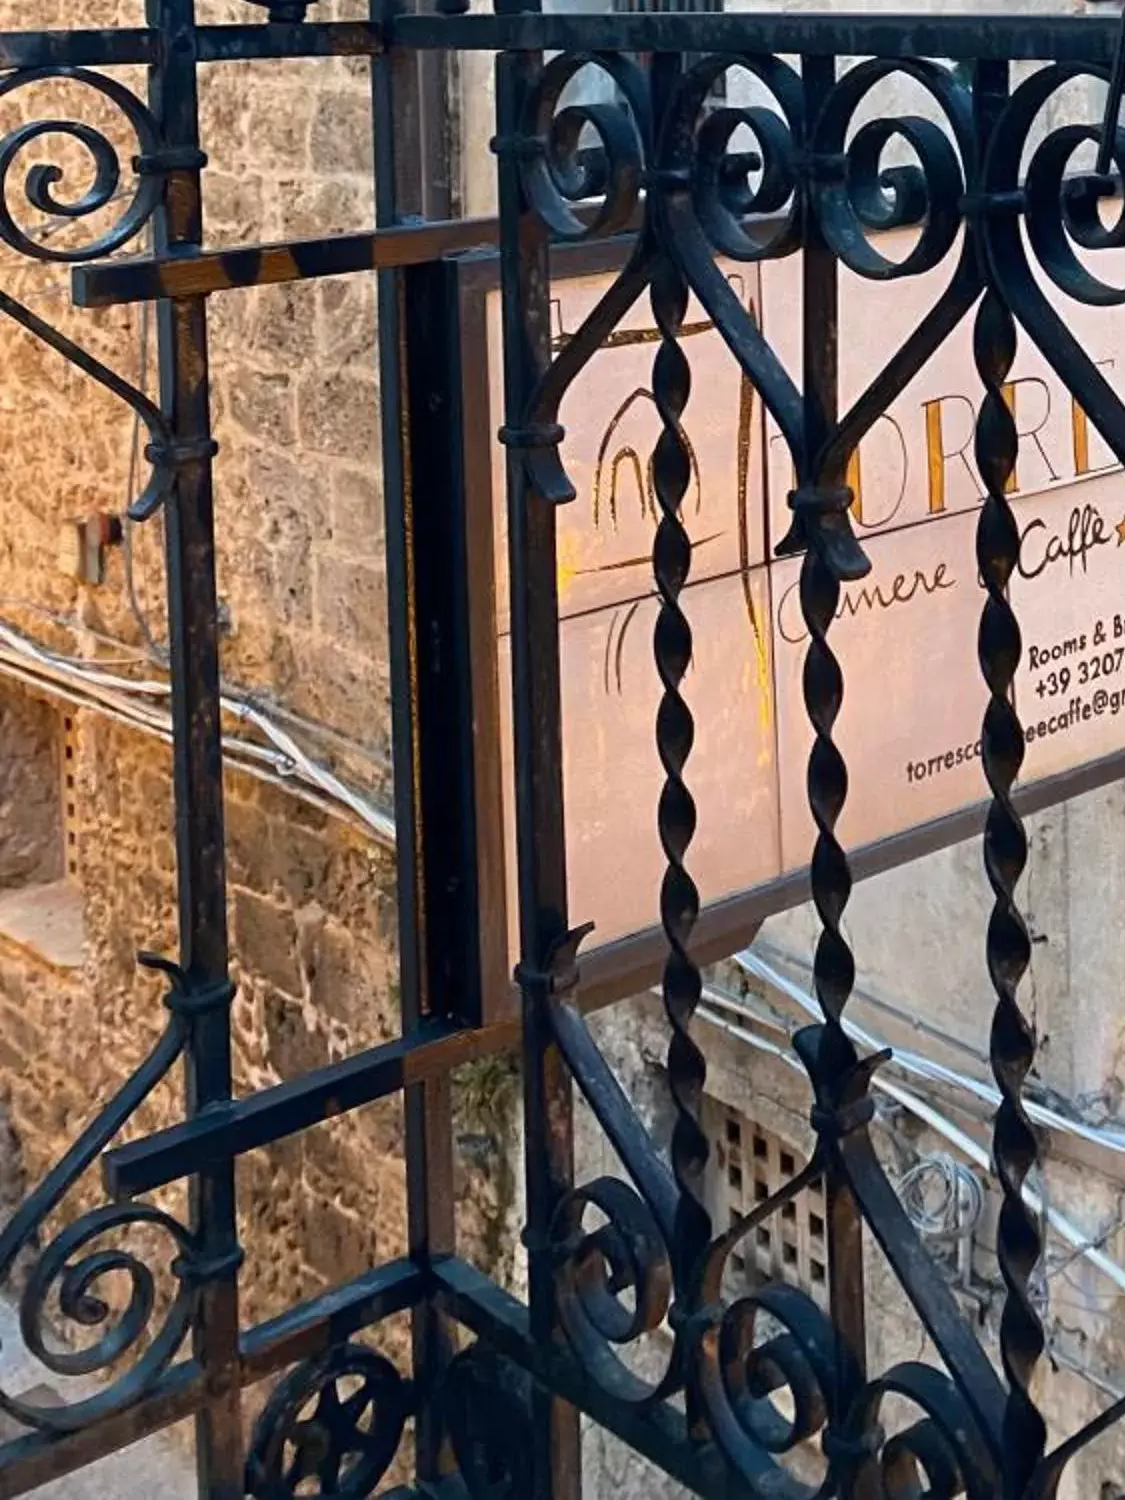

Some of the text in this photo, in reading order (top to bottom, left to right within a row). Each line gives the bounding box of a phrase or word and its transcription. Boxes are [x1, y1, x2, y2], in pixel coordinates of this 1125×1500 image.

[777, 502, 1112, 644] Cmere Caffè
[1028, 634, 1087, 672] Rooms
[1093, 620, 1106, 647] &
[1035, 666, 1071, 700] +39
